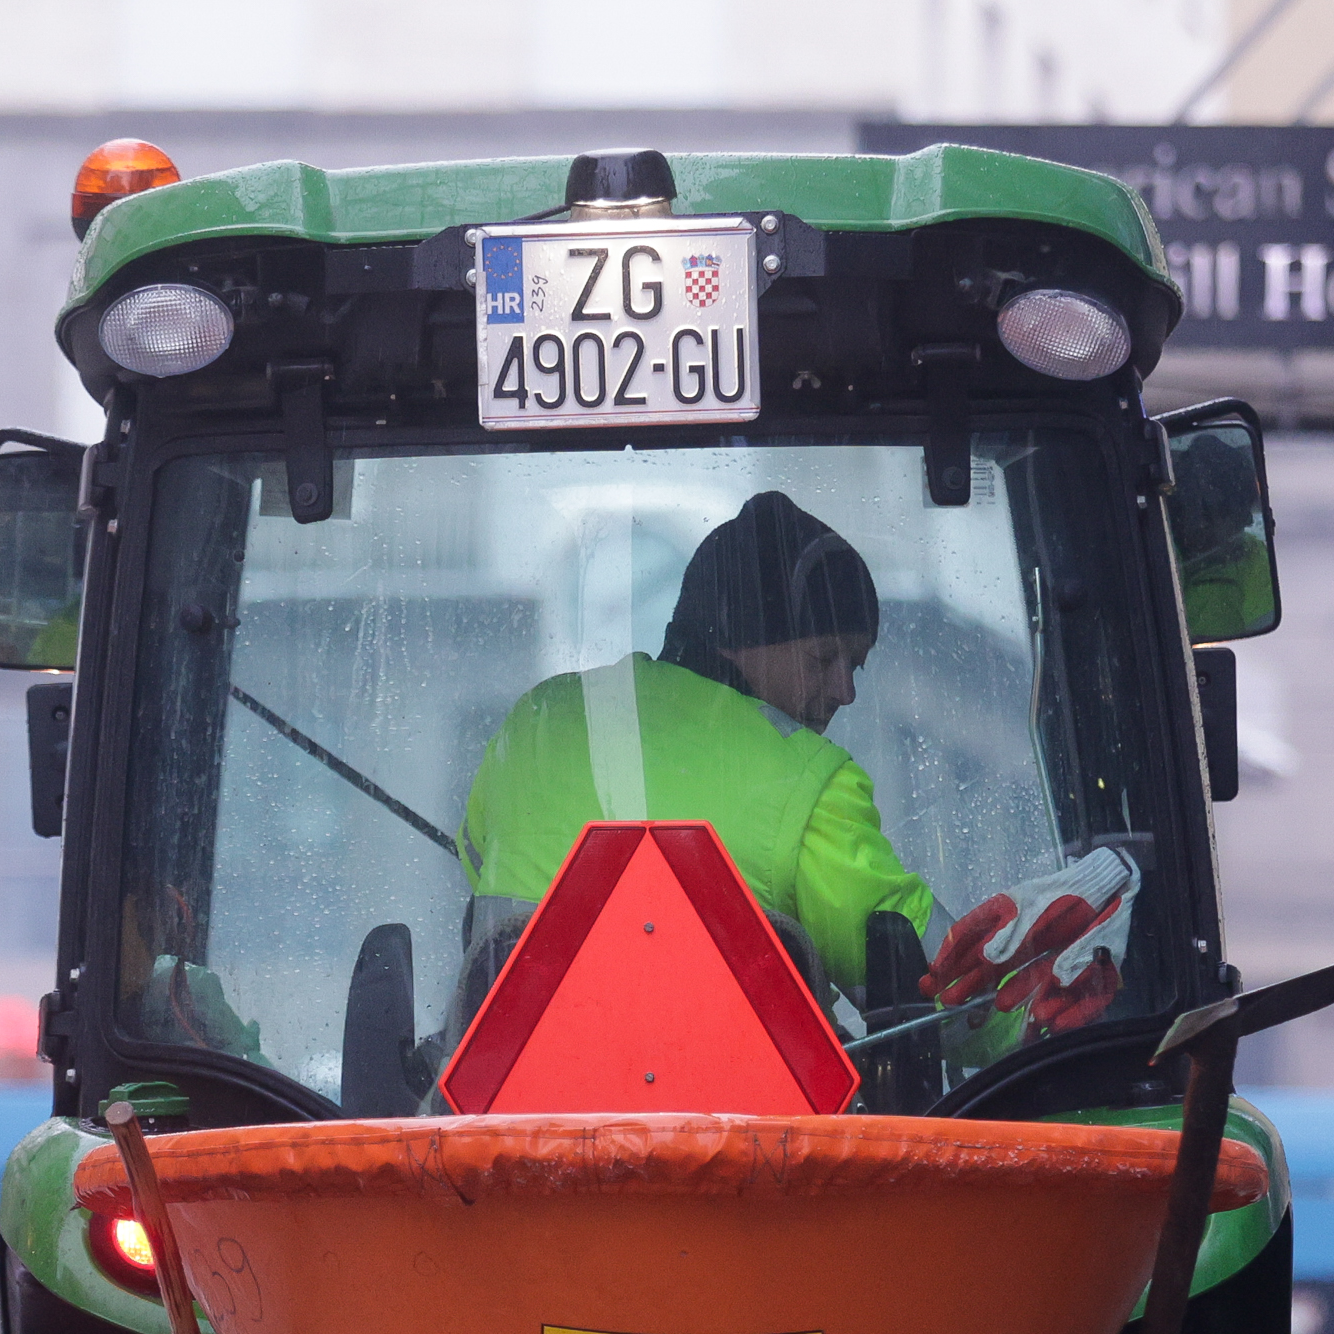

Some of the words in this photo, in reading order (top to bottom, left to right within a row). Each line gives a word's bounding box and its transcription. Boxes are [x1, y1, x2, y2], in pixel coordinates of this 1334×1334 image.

[1128, 142, 1304, 221] rican
[486, 293, 522, 316] HR
[530, 274, 549, 313] 239
[569, 245, 663, 322] ZG
[1167, 241, 1241, 321] ill
[493, 328, 745, 410] 4902-GU
